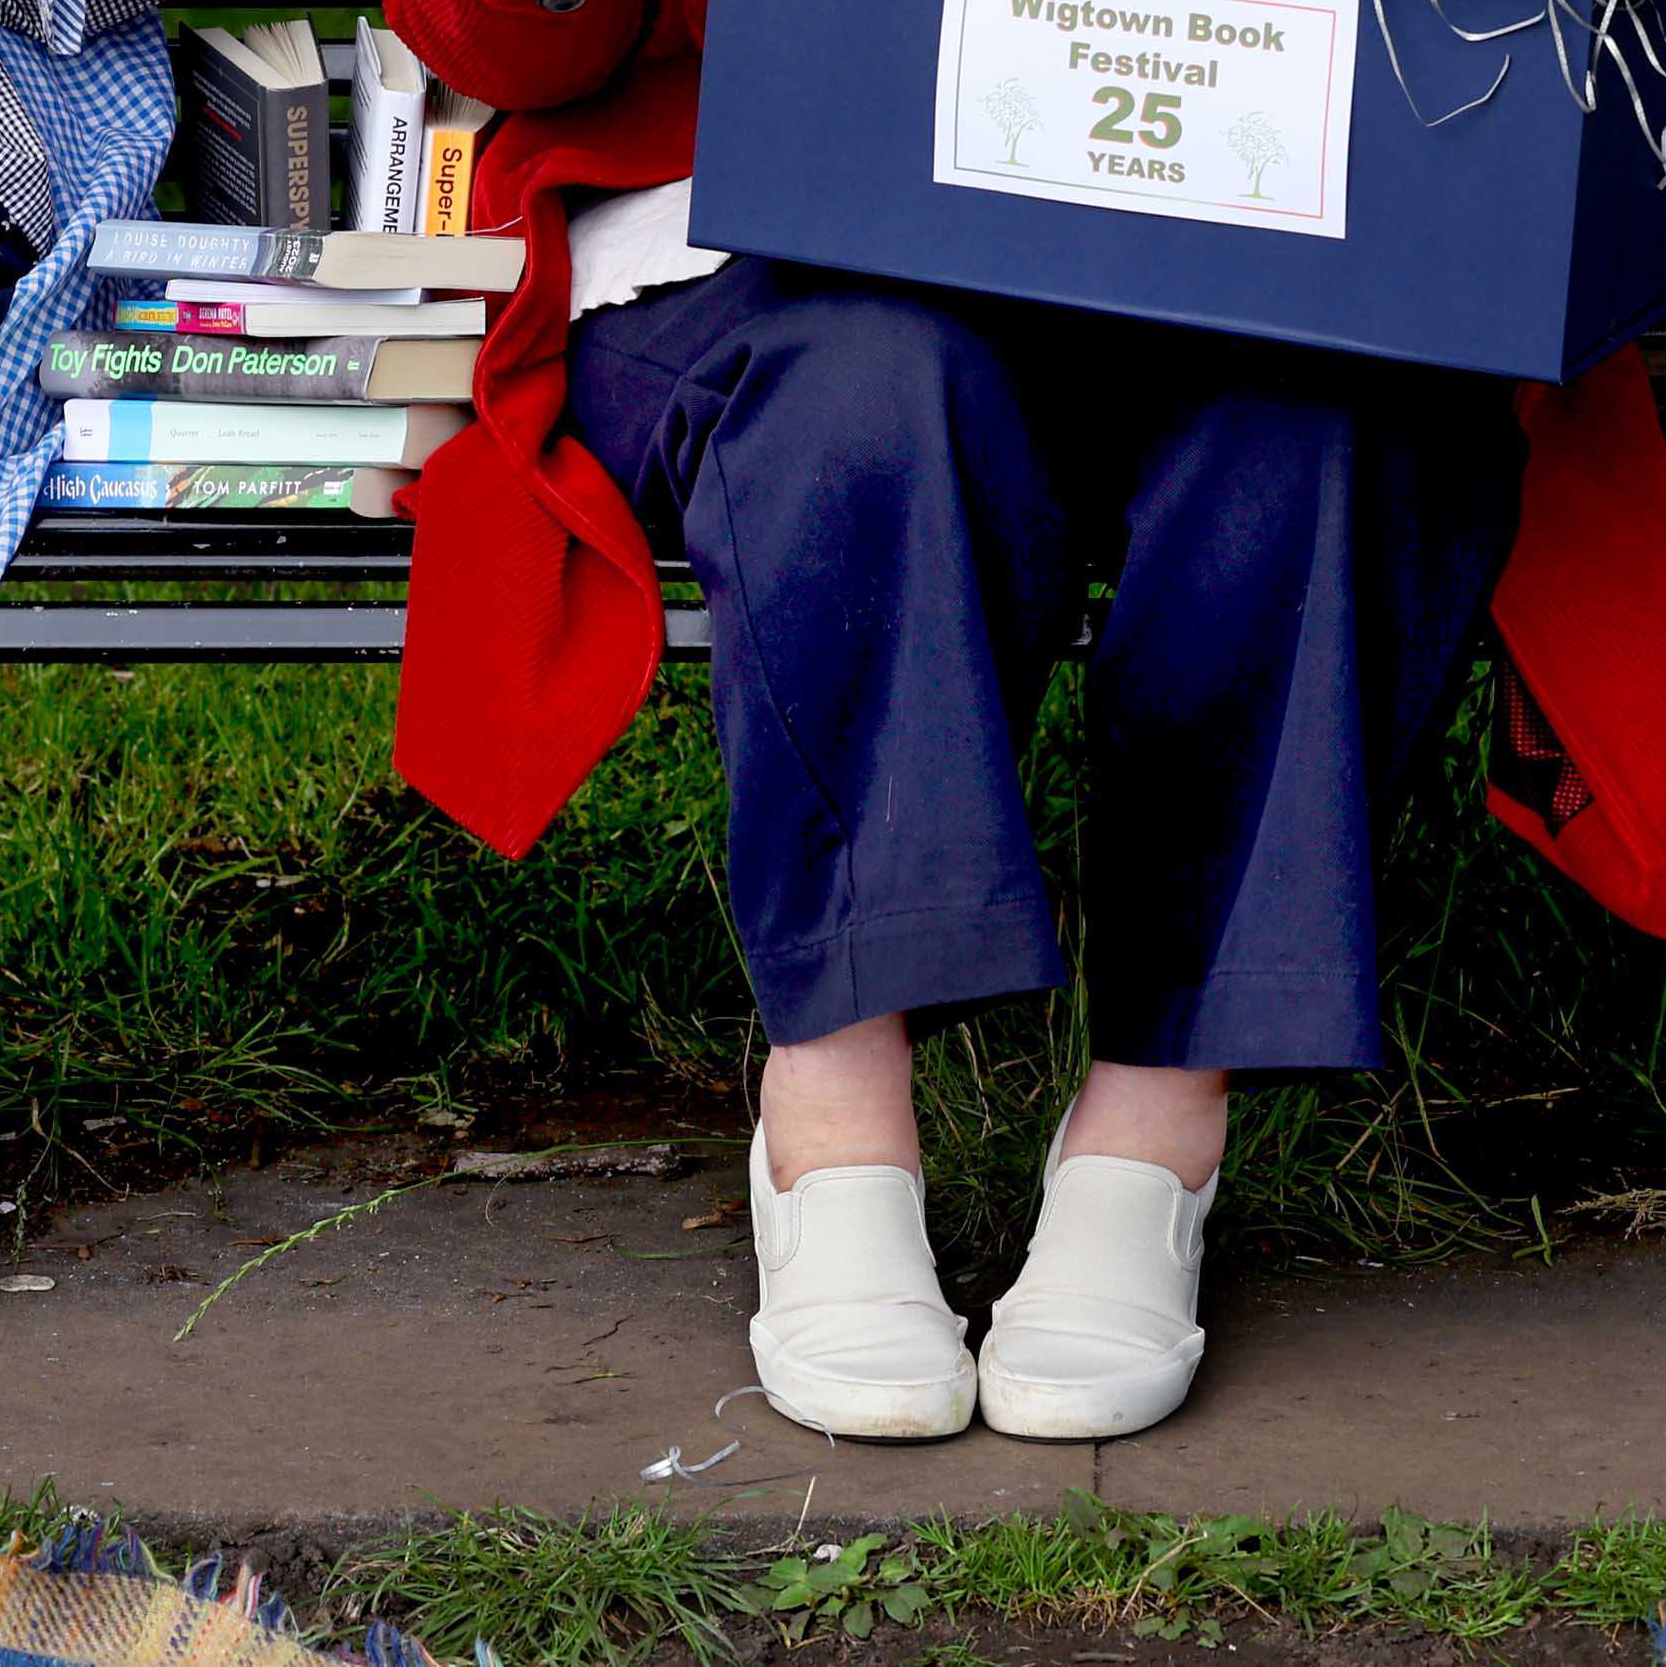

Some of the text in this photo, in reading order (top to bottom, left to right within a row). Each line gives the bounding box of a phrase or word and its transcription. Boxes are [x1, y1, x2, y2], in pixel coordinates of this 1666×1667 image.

[1187, 12, 1285, 52] Book
[1068, 41, 1218, 88] Festival
[1088, 85, 1183, 150] 25
[286, 105, 310, 230] SUPERSPY
[384, 116, 408, 234] ARRANGEME
[1086, 150, 1186, 184] YEARS
[436, 147, 463, 238] Super-
[114, 230, 251, 253] LOUISE DOUGHTY
[285, 237, 302, 273] 2023
[123, 251, 159, 264] BIRD
[166, 253, 182, 265] IN
[190, 255, 249, 270] WINTER
[49, 343, 338, 379] Toy Fights Don Paterson
[44, 473, 158, 505] High Caucasus
[193, 481, 302, 495] TOM PARFITT
